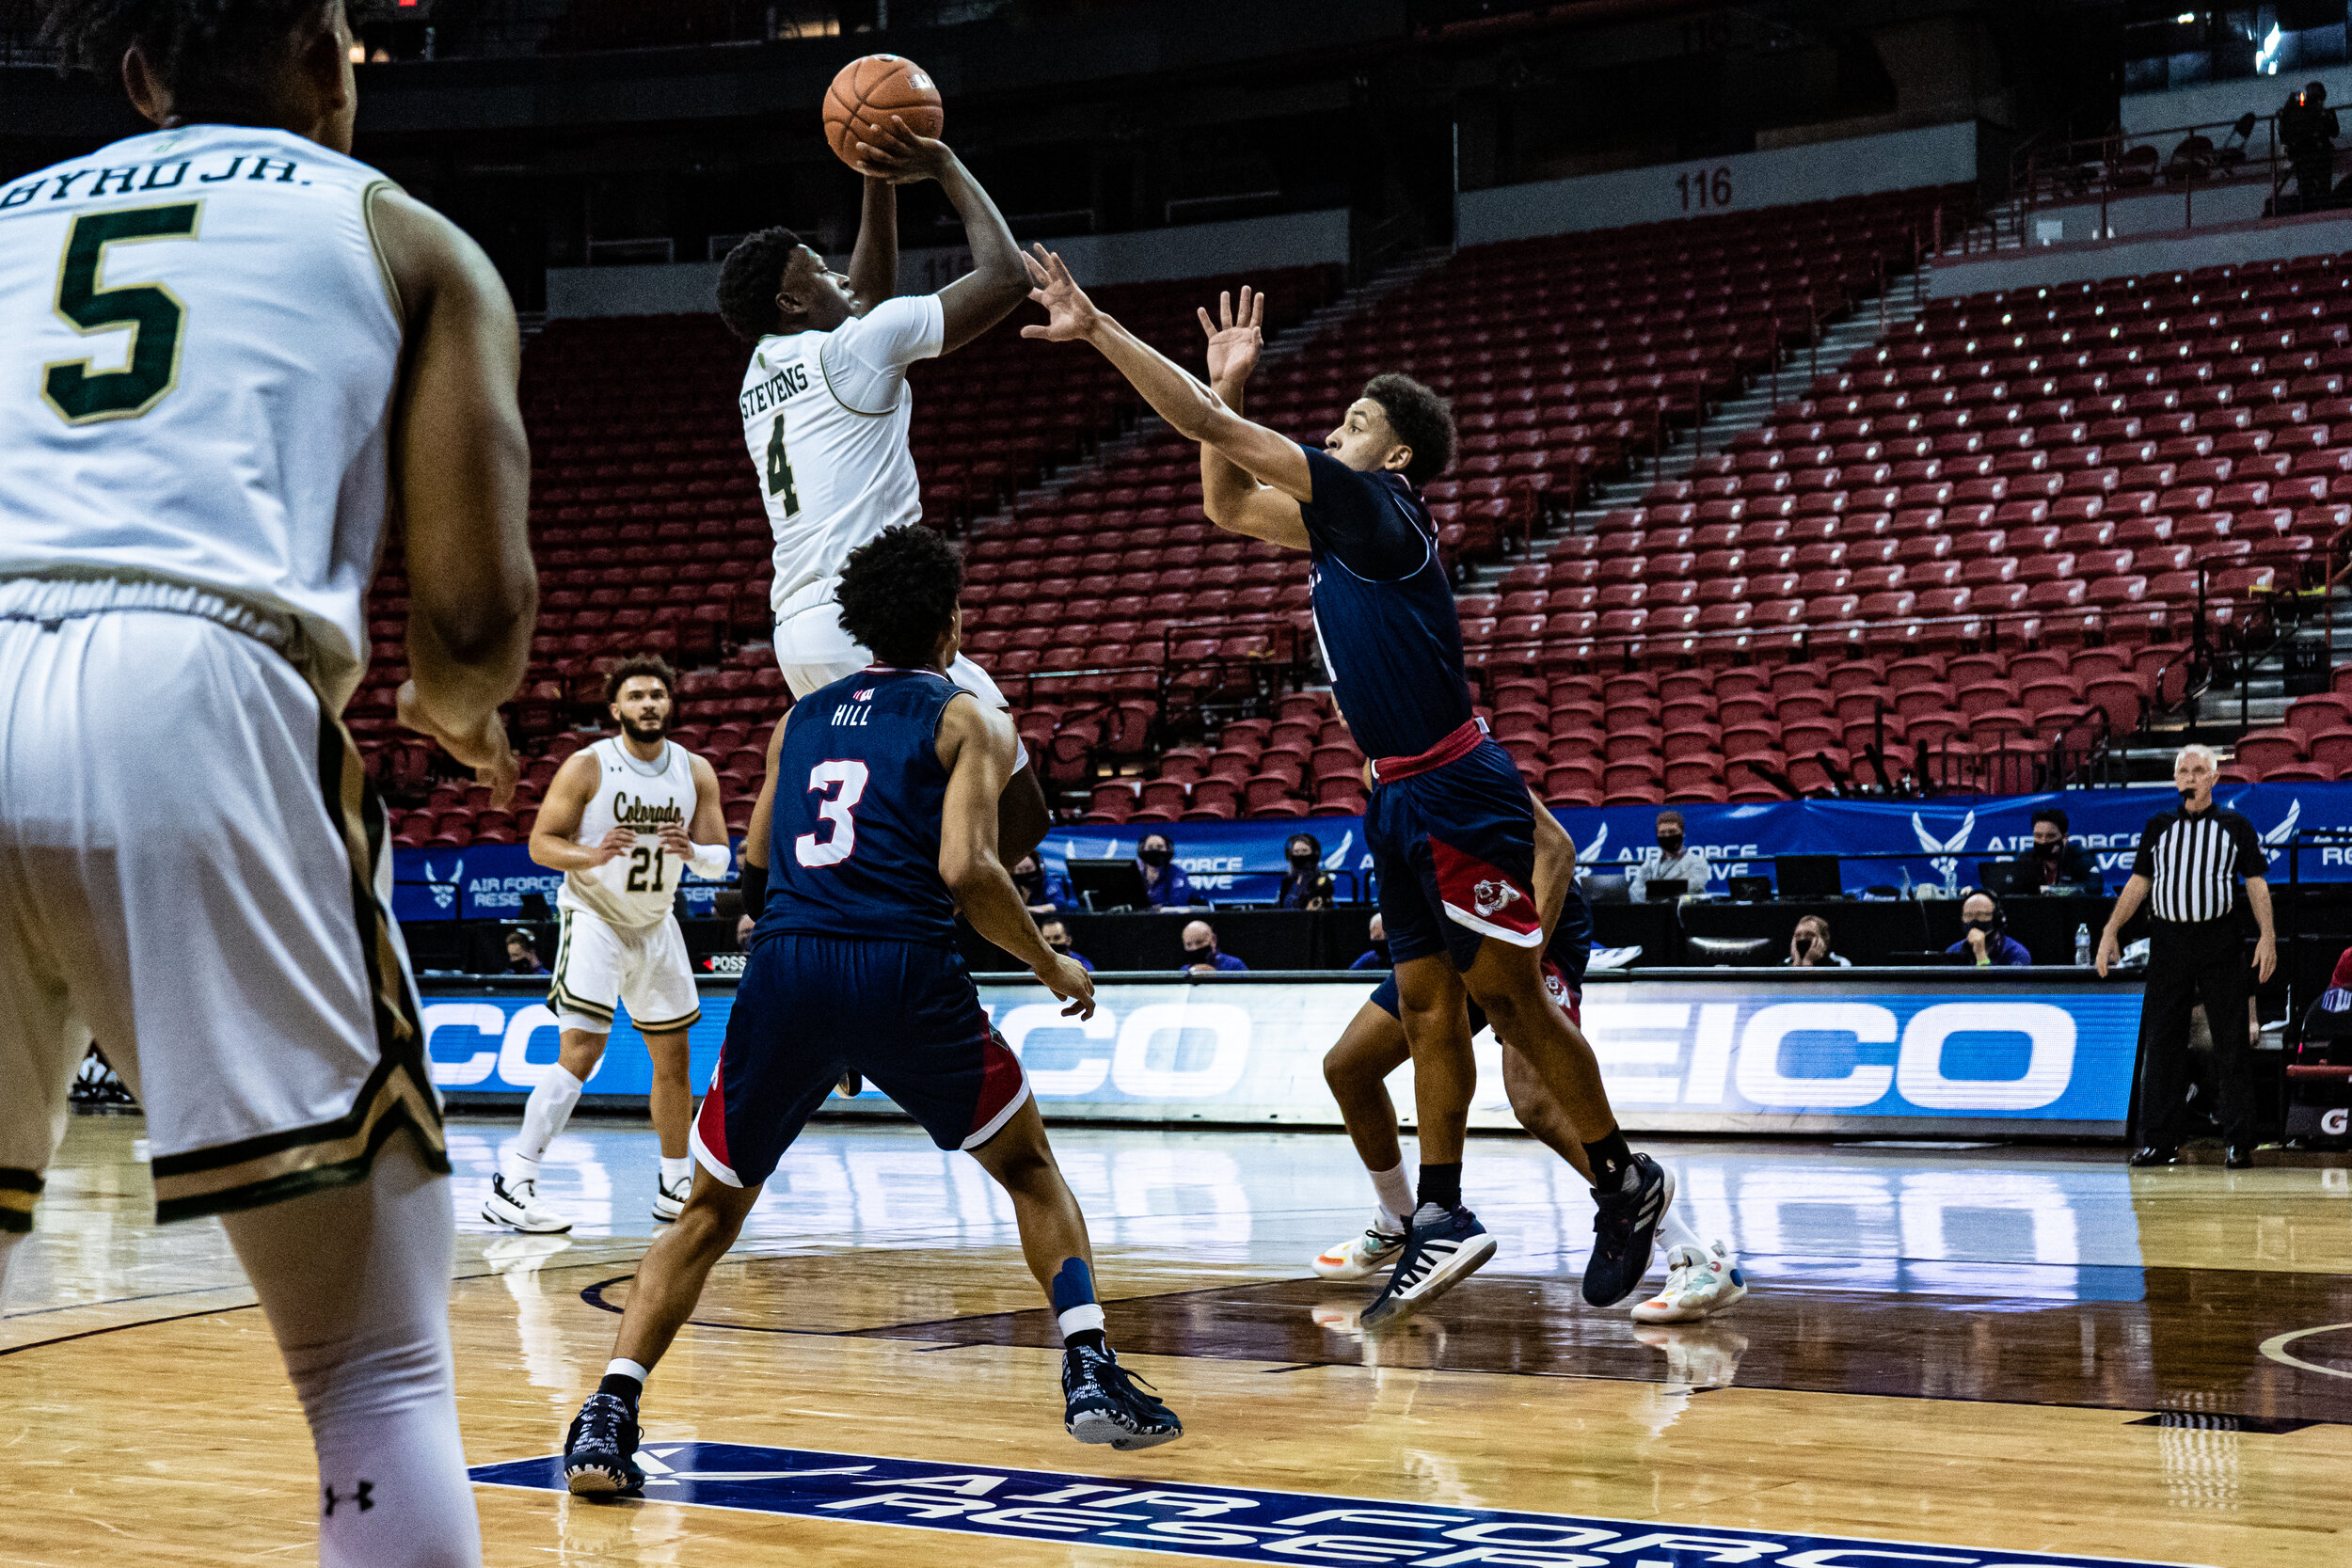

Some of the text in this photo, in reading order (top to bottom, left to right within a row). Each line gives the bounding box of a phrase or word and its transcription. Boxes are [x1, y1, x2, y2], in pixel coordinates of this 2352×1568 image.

[1677, 166, 1732, 212] 116
[40, 198, 206, 427] 5
[740, 363, 809, 420] STEVENS
[765, 410, 801, 519] 4
[831, 704, 872, 726] HILL
[613, 791, 685, 828] Colorado
[795, 758, 869, 869] 3
[625, 846, 664, 893] 21
[1687, 844, 1758, 860] ORCE
[469, 875, 564, 894] AIR FORCE
[711, 955, 747, 972] POSS
[978, 1003, 1252, 1098] CO
[2321, 1108, 2349, 1135] G
[850, 1474, 2084, 1568] AIR FORC
